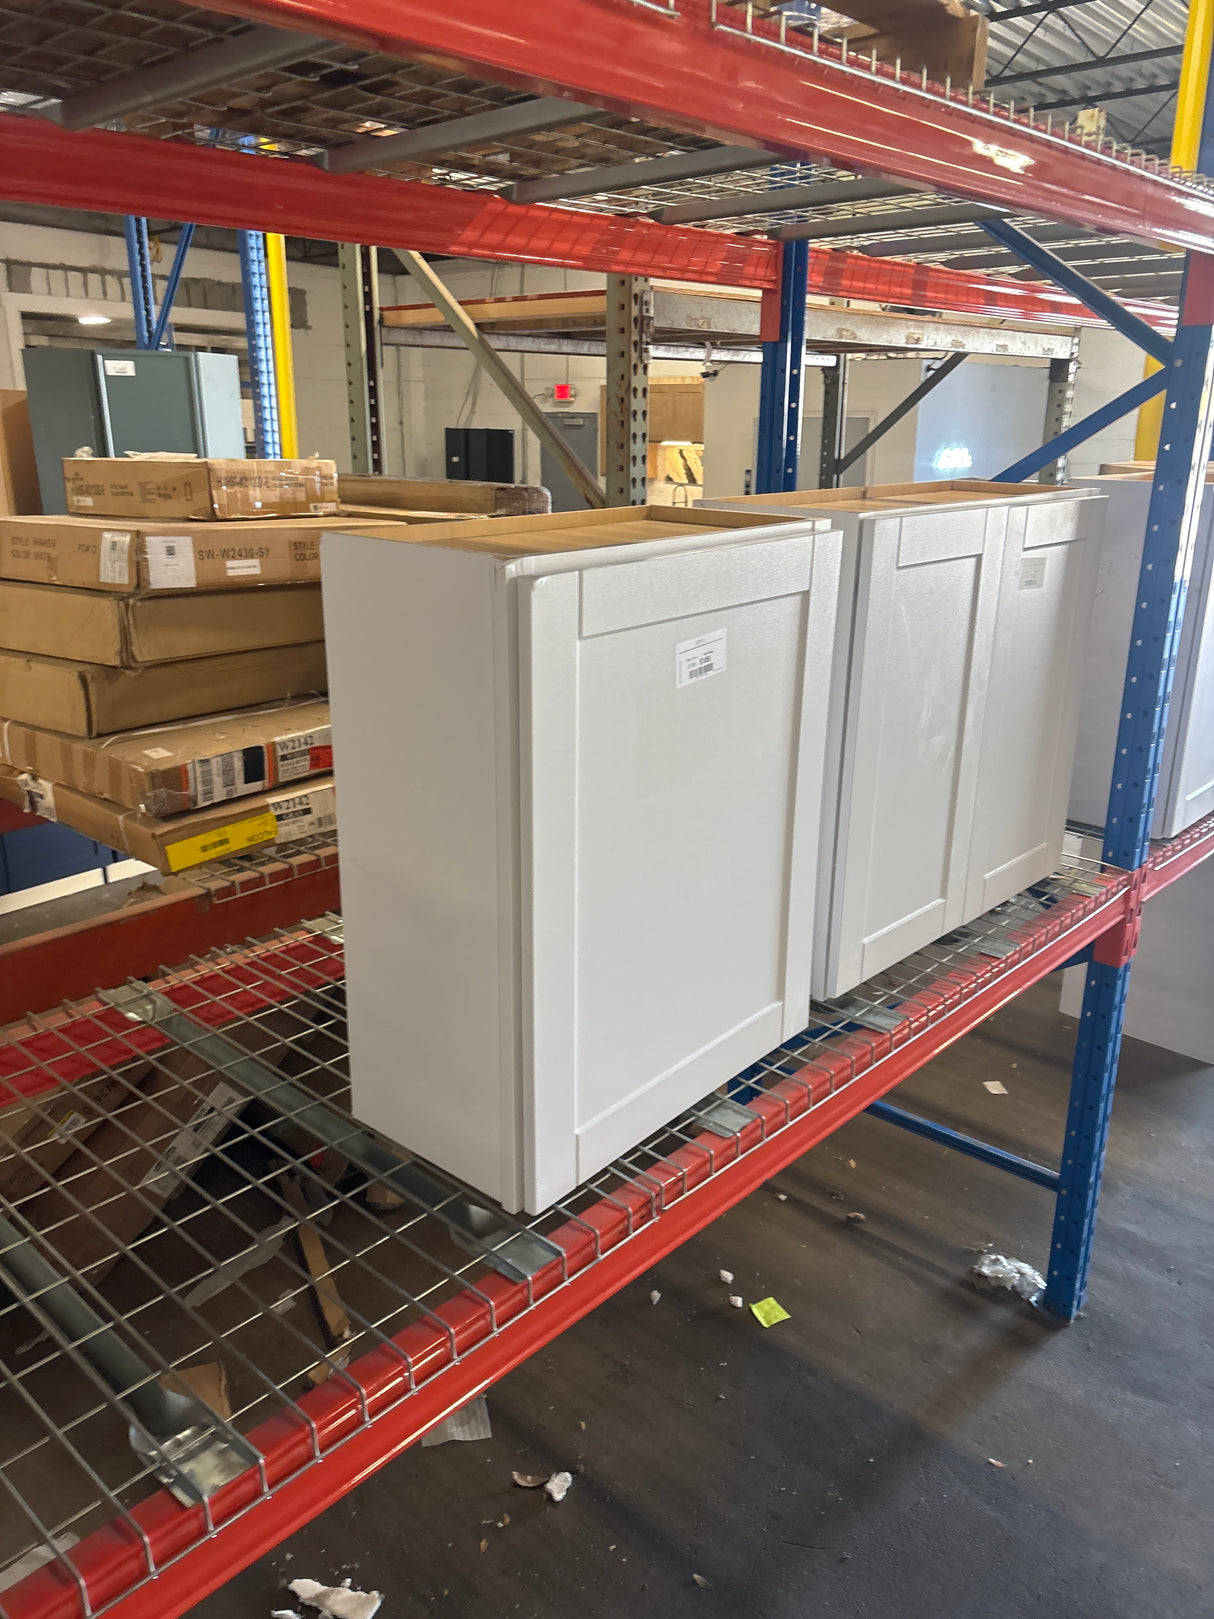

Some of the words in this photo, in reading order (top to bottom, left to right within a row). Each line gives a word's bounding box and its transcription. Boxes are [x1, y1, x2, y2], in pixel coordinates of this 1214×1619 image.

[293, 540, 316, 551] STYLE
[278, 735, 315, 752] W2142
[271, 794, 311, 811] W2142
